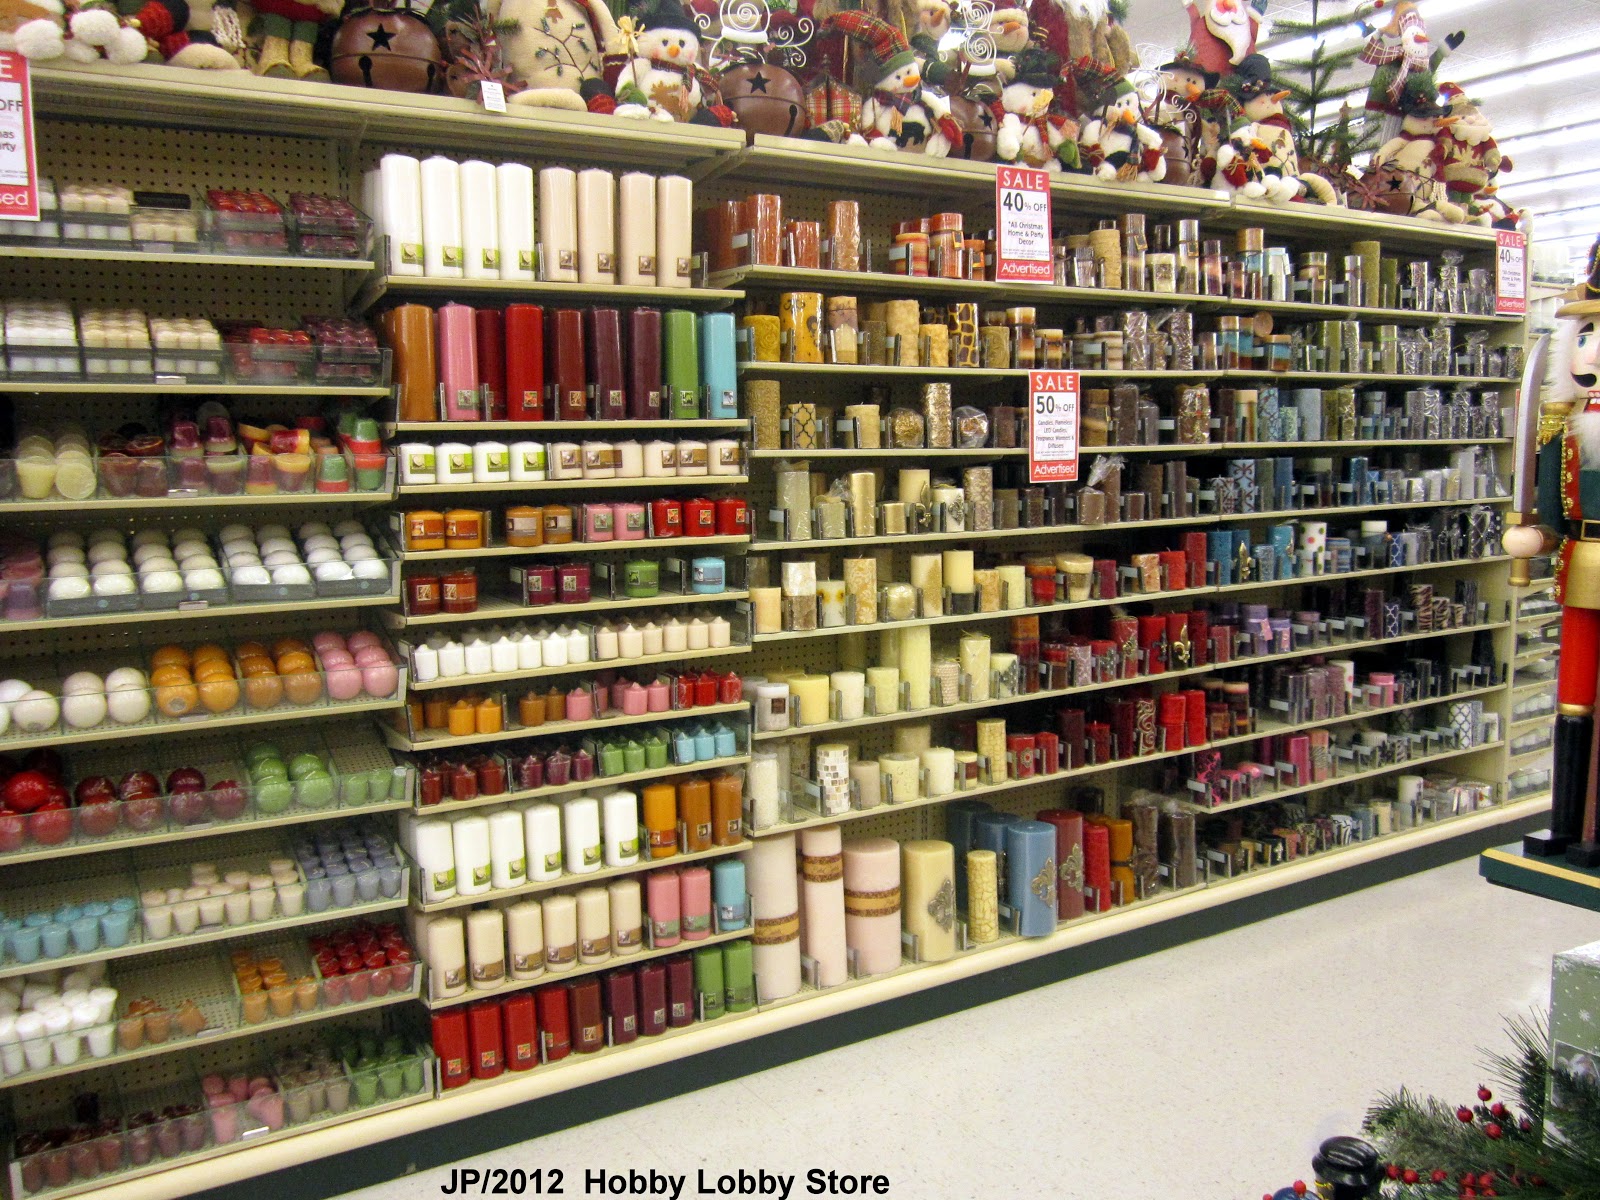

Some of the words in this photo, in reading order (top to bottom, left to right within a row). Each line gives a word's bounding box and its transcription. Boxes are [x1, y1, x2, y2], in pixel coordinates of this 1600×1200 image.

[1003, 171, 1043, 190] SALE
[1033, 203, 1047, 212] OFF
[1019, 222, 1044, 230] Christmas
[1499, 233, 1521, 247] SALE
[1001, 262, 1050, 275] Advertised
[1036, 375, 1074, 391] SALE
[1063, 404, 1074, 412] OFF
[1034, 463, 1075, 475] Advertised
